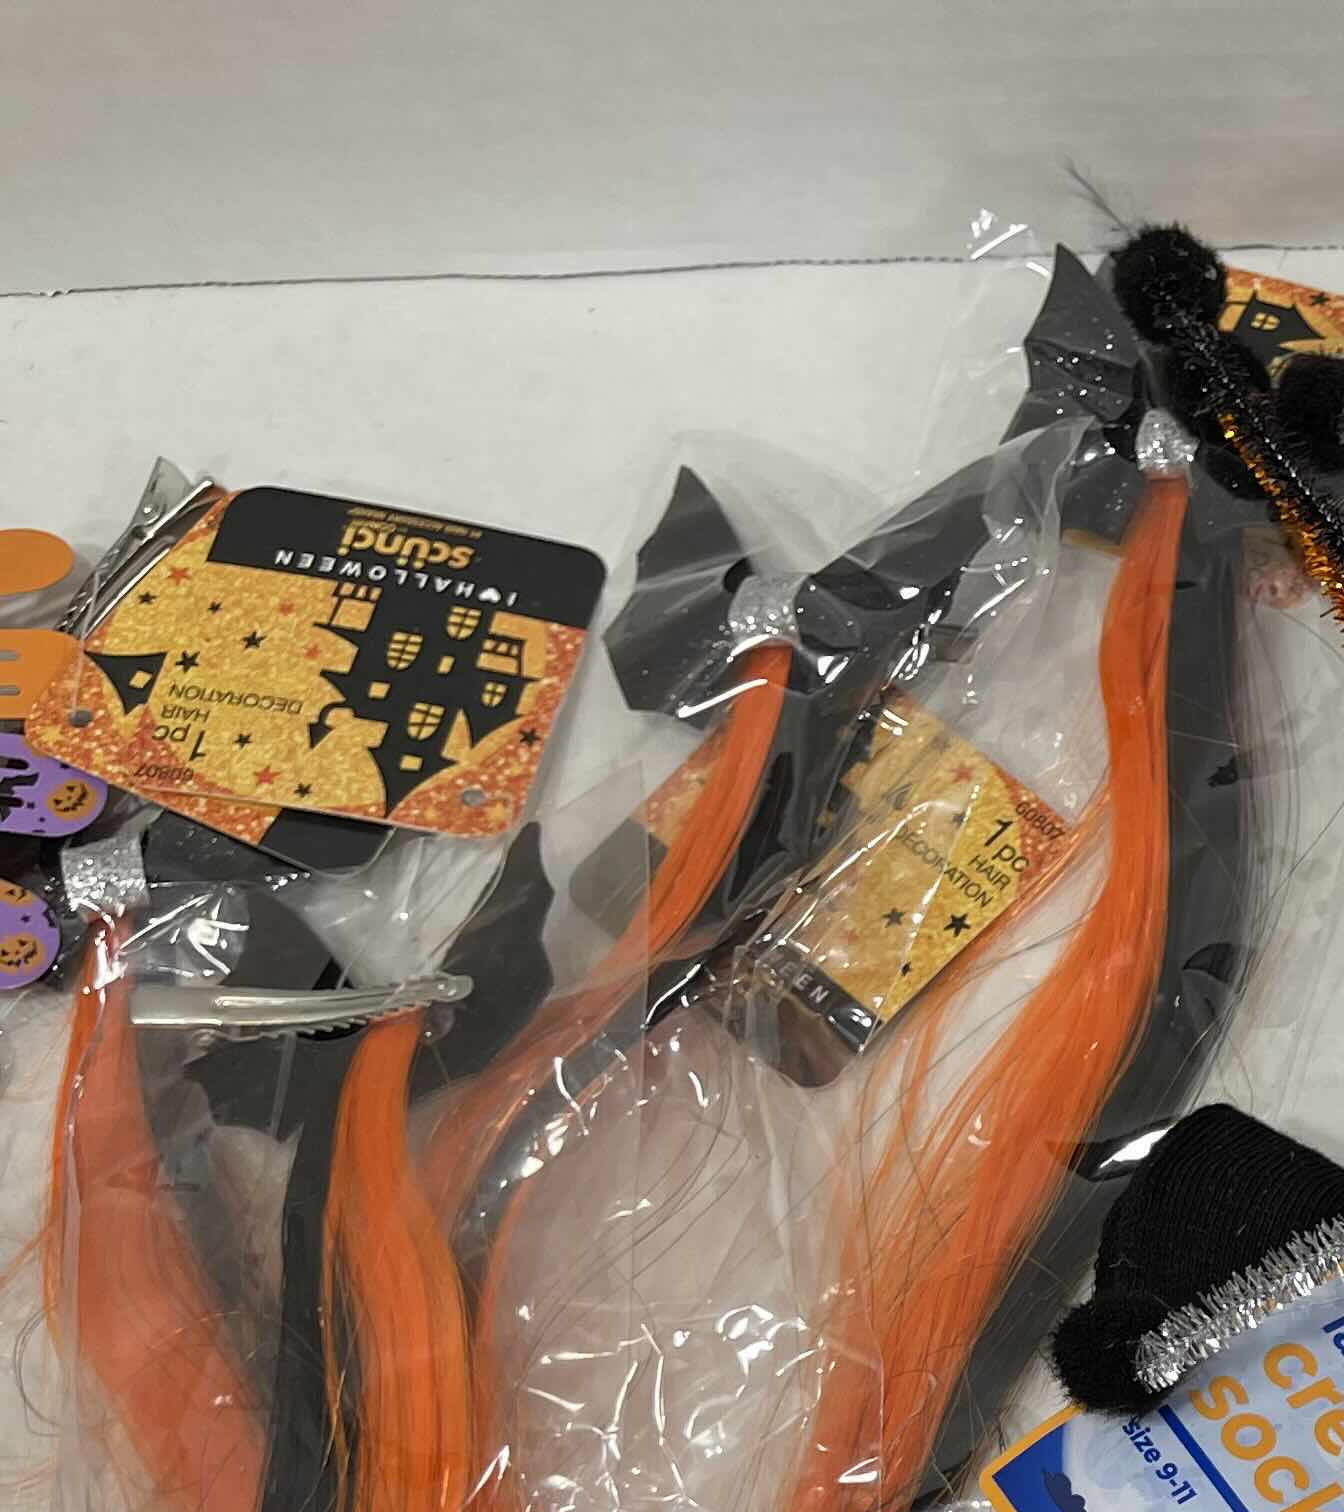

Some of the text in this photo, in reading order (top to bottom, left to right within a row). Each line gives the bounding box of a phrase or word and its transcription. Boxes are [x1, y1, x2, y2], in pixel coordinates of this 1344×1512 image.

[338, 523, 475, 571] scünci
[274, 549, 480, 600] HALLOWEEN
[161, 705, 211, 724] HAIR
[167, 682, 303, 715] DECORATION
[1015, 801, 1066, 840] 60807
[969, 854, 1012, 892] HAIR
[1122, 1415, 1198, 1506] size 9-11
